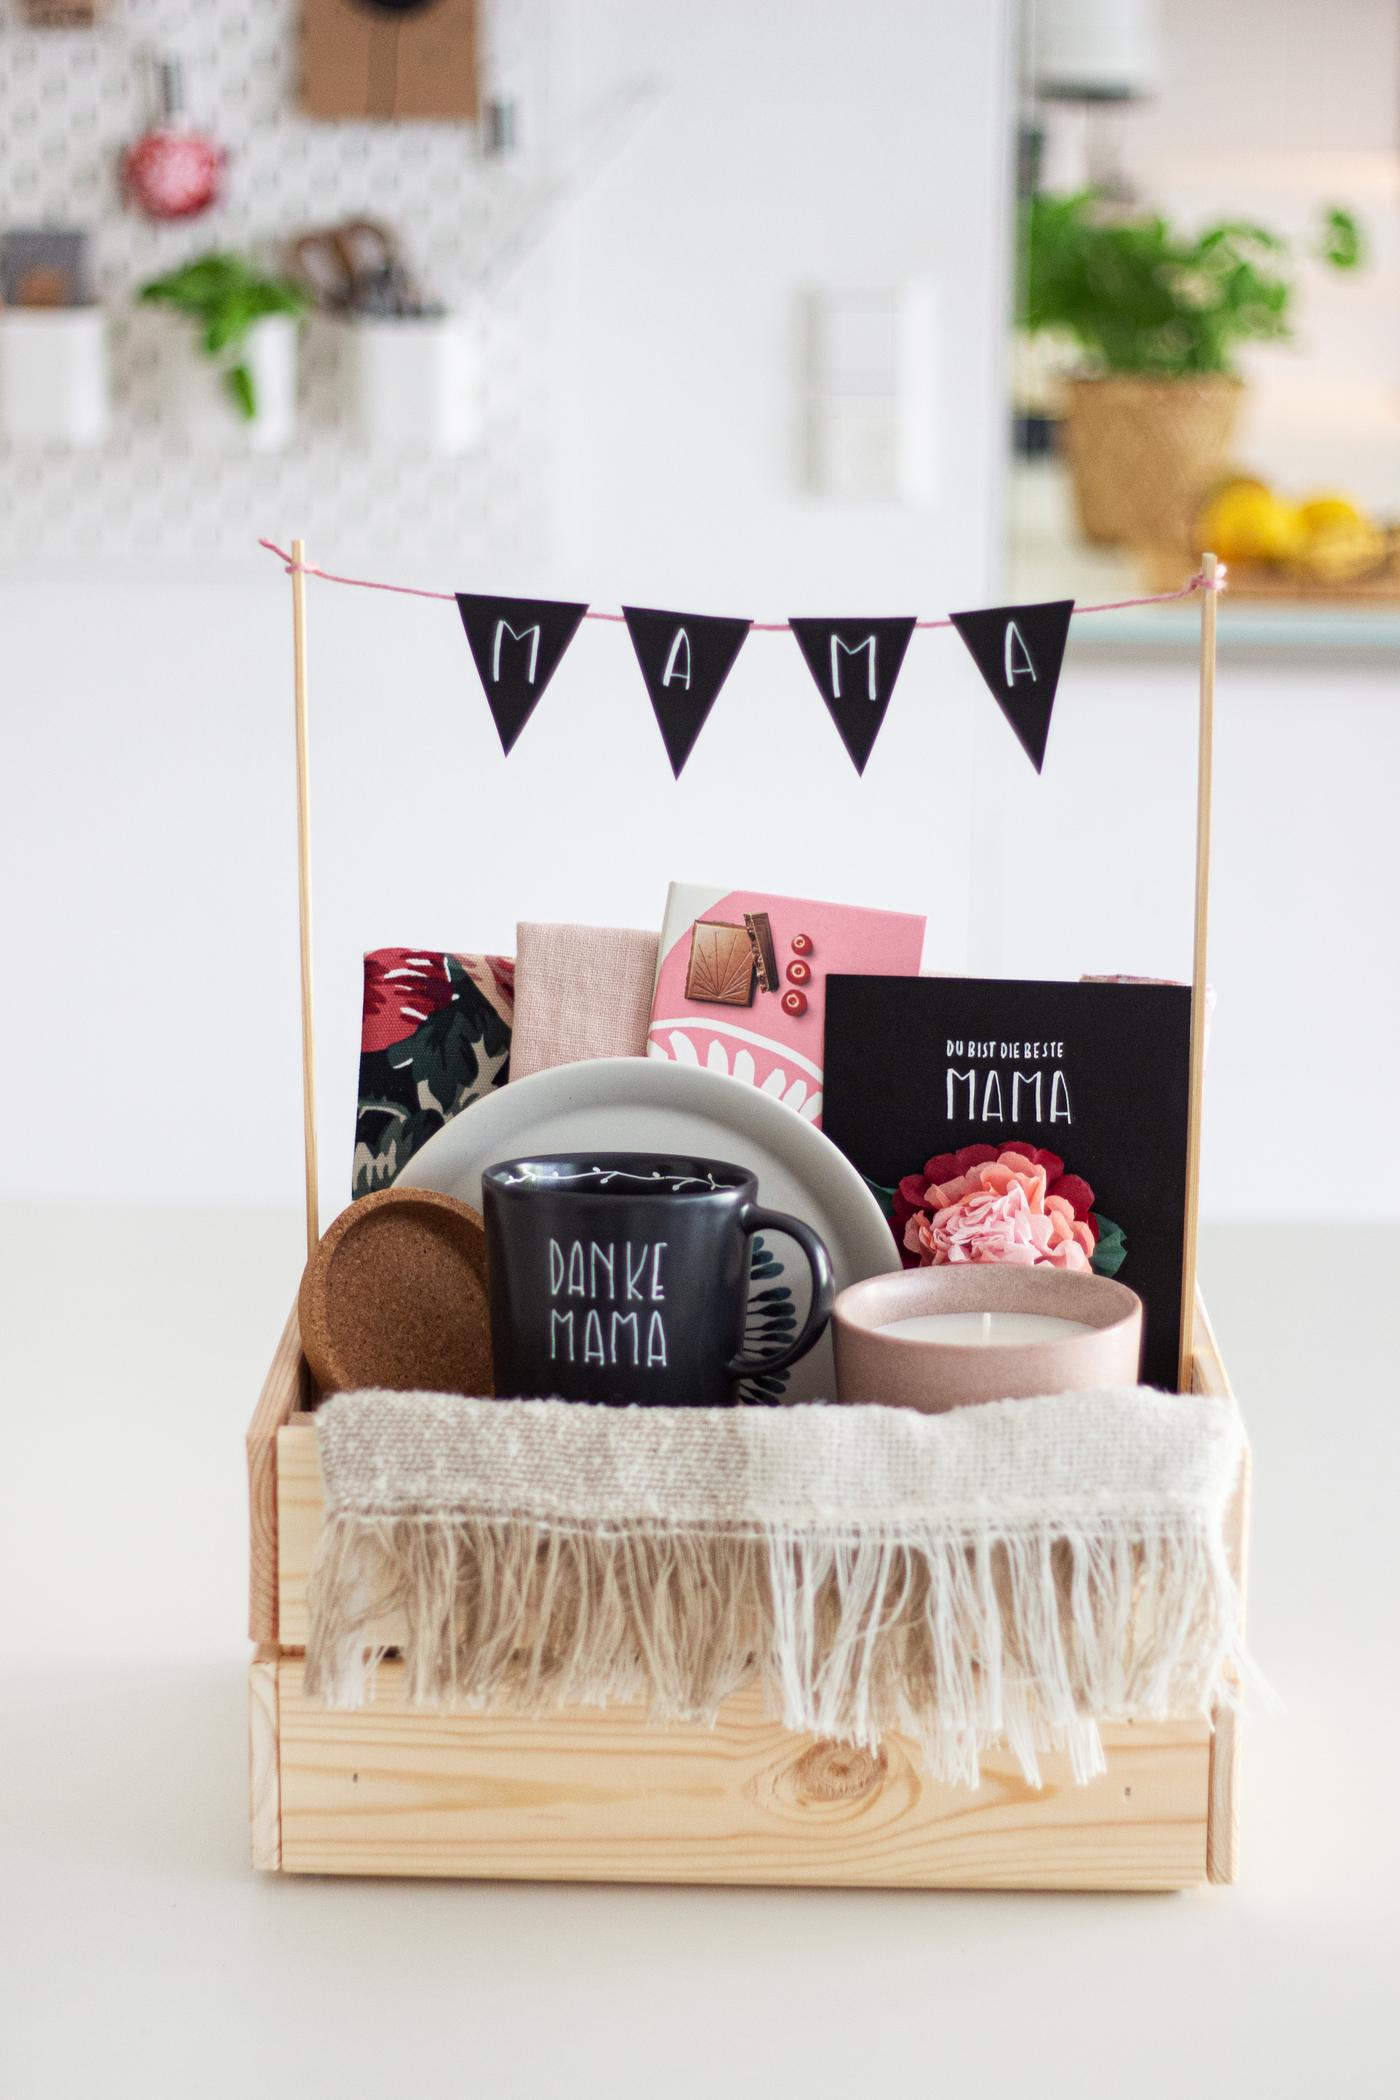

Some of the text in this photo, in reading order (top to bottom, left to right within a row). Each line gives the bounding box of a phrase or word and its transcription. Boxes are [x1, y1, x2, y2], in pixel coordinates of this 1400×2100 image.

[492, 619, 1038, 701] MAMA
[946, 1039, 1064, 1059] DU BIST DIE BESTE
[946, 1067, 1072, 1125] MAMA
[549, 1238, 668, 1301] DANKE
[550, 1308, 667, 1368] MAMA
